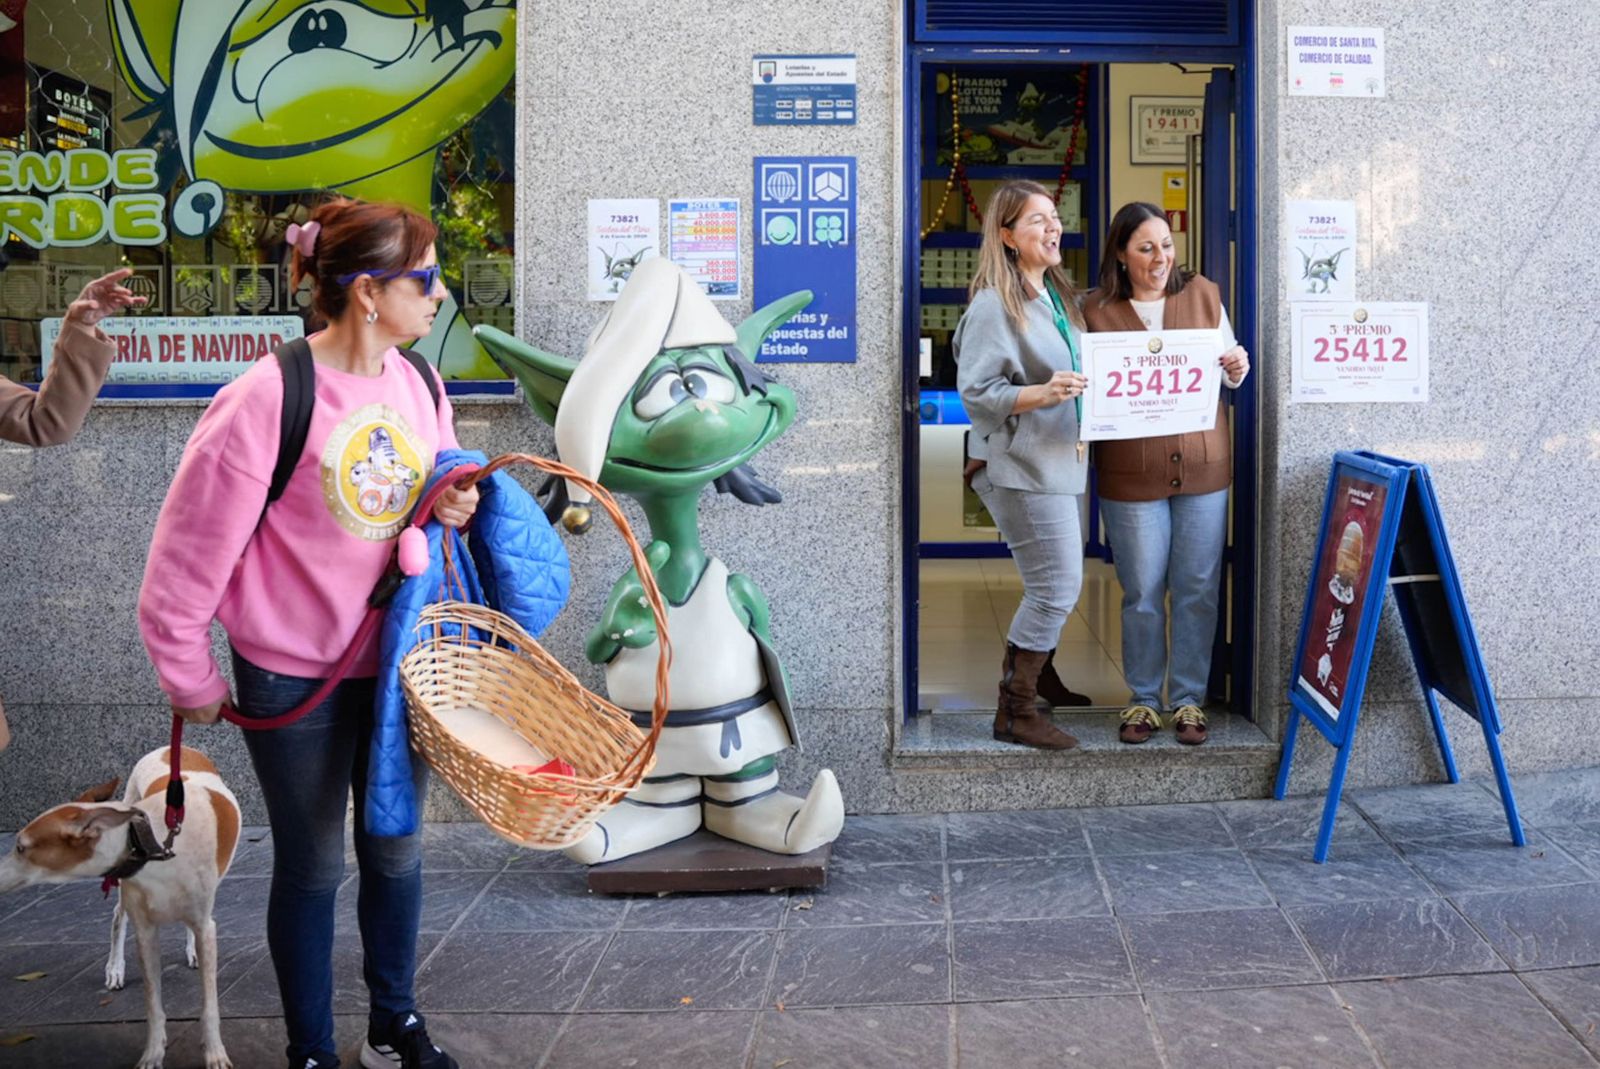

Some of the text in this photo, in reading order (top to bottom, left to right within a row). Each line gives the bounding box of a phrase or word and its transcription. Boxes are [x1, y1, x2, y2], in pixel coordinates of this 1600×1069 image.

[1294, 36, 1328, 46] COMERCIO
[1329, 37, 1337, 47] DE
[1340, 37, 1360, 47] SANTA
[1299, 53, 1333, 64] COMERCIO
[1334, 53, 1342, 64] DE
[958, 78, 1008, 87] TRAEMOS
[55, 88, 93, 111] BOTES
[975, 96, 1002, 105] TODA
[1160, 109, 1195, 117] PREMIO
[610, 215, 639, 223] 73821
[1309, 216, 1336, 224] 73821
[786, 311, 829, 327] rías y
[768, 326, 848, 342] puestas del
[1343, 324, 1392, 335] PREMIO
[158, 334, 186, 363] DE
[761, 342, 809, 355] Estado
[1313, 337, 1408, 362] 25412
[1137, 354, 1188, 367] PREMIO
[1106, 367, 1203, 398] 25412
